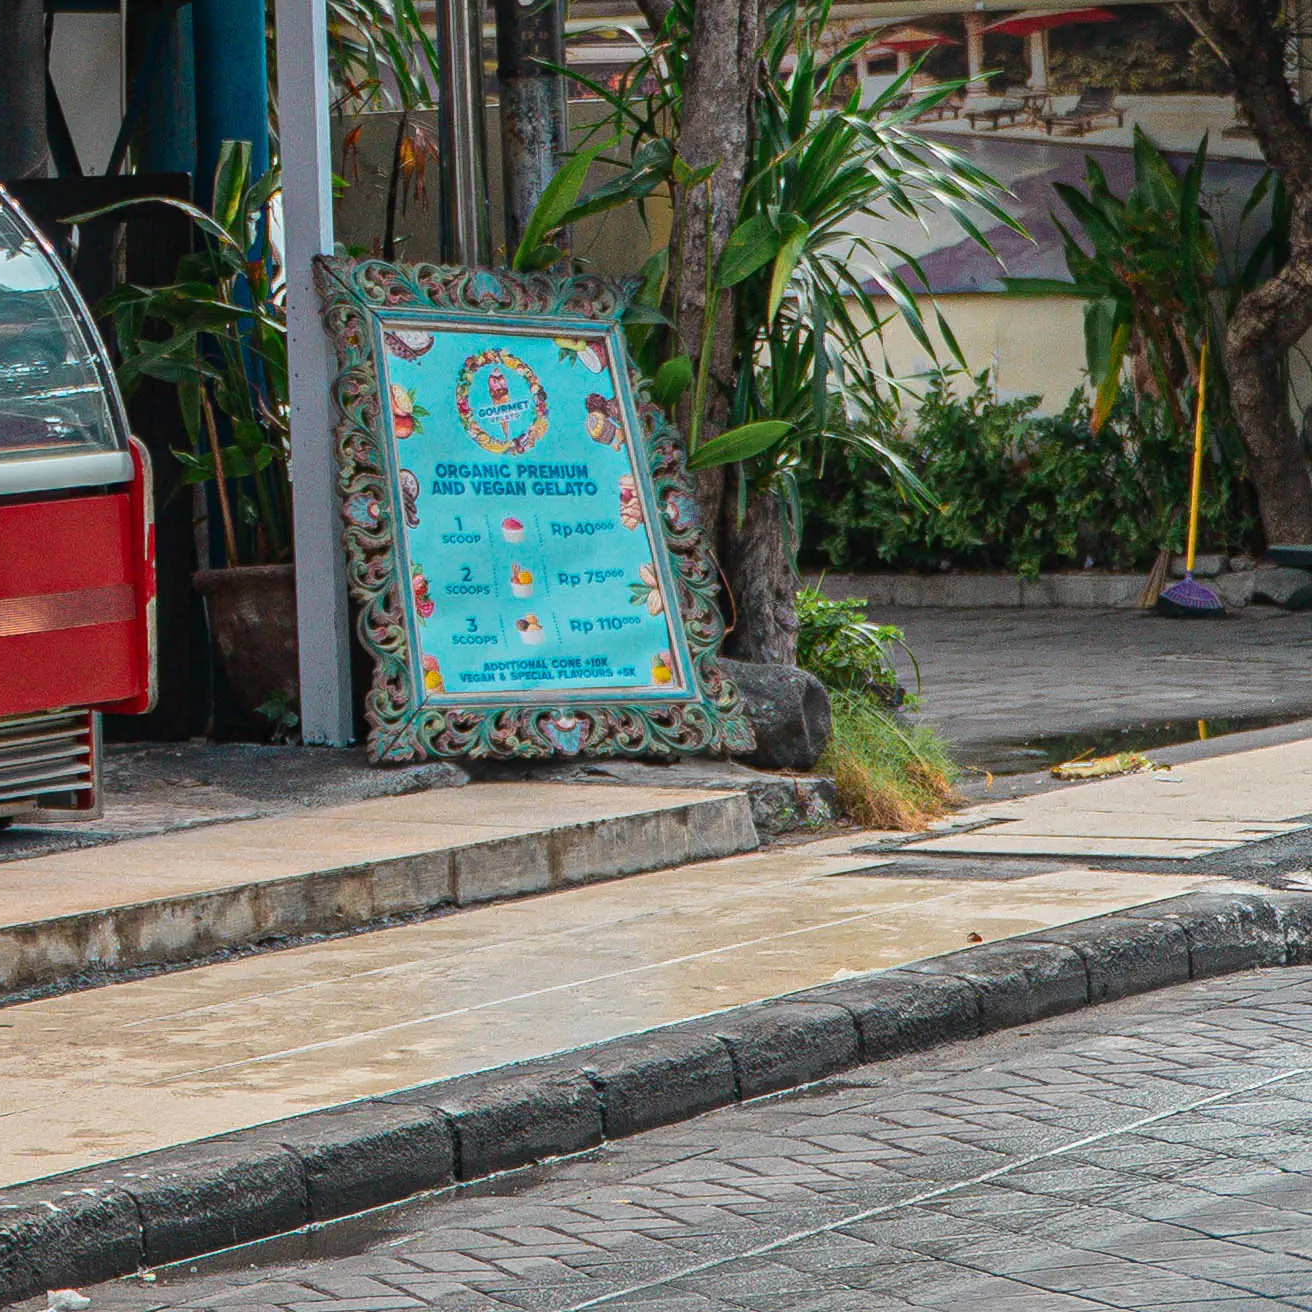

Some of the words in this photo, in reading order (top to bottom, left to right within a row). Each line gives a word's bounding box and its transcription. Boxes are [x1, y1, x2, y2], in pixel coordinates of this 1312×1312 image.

[478, 399, 529, 417] GOURMET
[435, 463, 511, 479] ORGANIC
[517, 464, 589, 479] PREMIUM
[432, 481, 465, 496] AND
[470, 481, 526, 496] VEGAN
[532, 481, 598, 496] GELATO
[454, 516, 463, 531] 1
[551, 523, 573, 538] Rp
[442, 534, 481, 544] SCOOP
[460, 567, 472, 582] 2
[558, 572, 580, 587] Rp
[446, 585, 491, 595] SCOOPS
[466, 618, 478, 632] 3
[569, 620, 593, 635] Rp
[452, 635, 498, 645] SCOOPS
[483, 659, 547, 672] ADDITIONAL
[552, 659, 581, 669] CONE
[460, 672, 495, 683] VEGAN
[510, 670, 555, 681] SPECIAL
[558, 668, 613, 679] FLAVOURS
